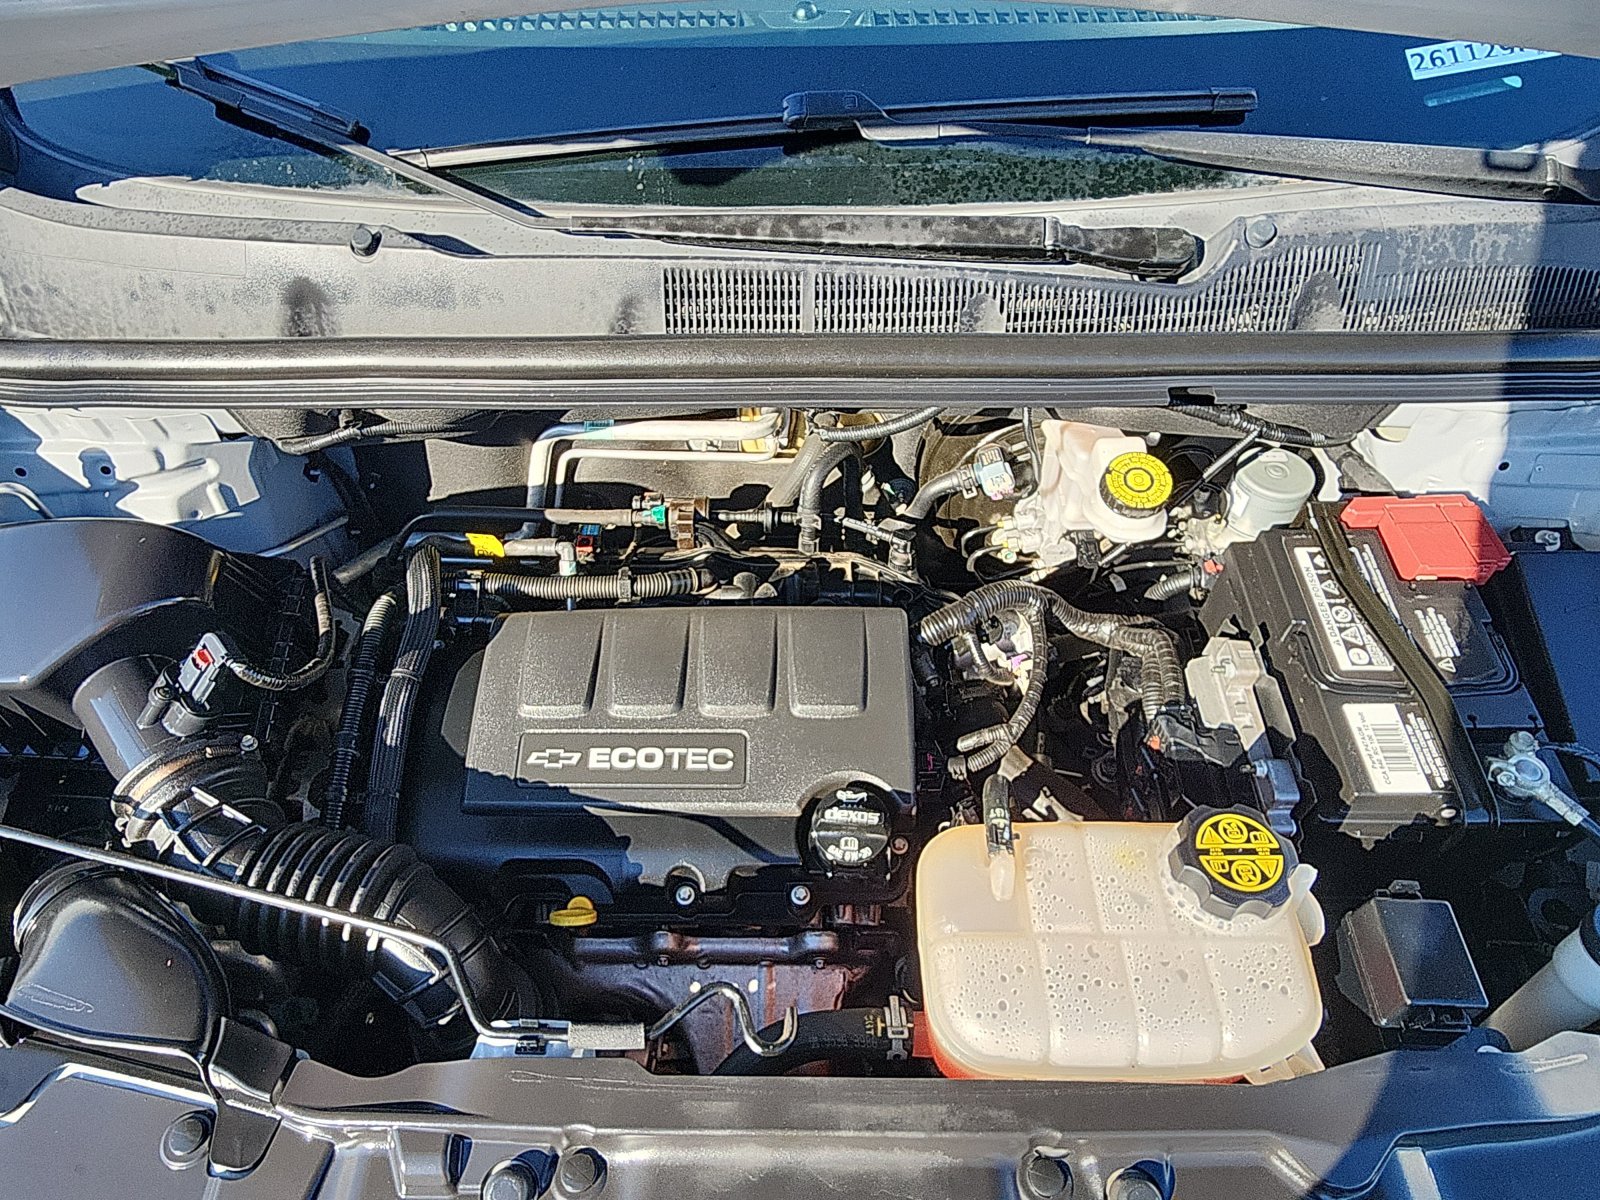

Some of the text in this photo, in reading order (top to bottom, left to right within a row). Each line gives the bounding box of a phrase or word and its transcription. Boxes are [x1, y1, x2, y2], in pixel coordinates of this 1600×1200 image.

[588, 747, 734, 770] ECOTEC
[1382, 771, 1392, 785] CCA
[824, 806, 880, 825] dexos
